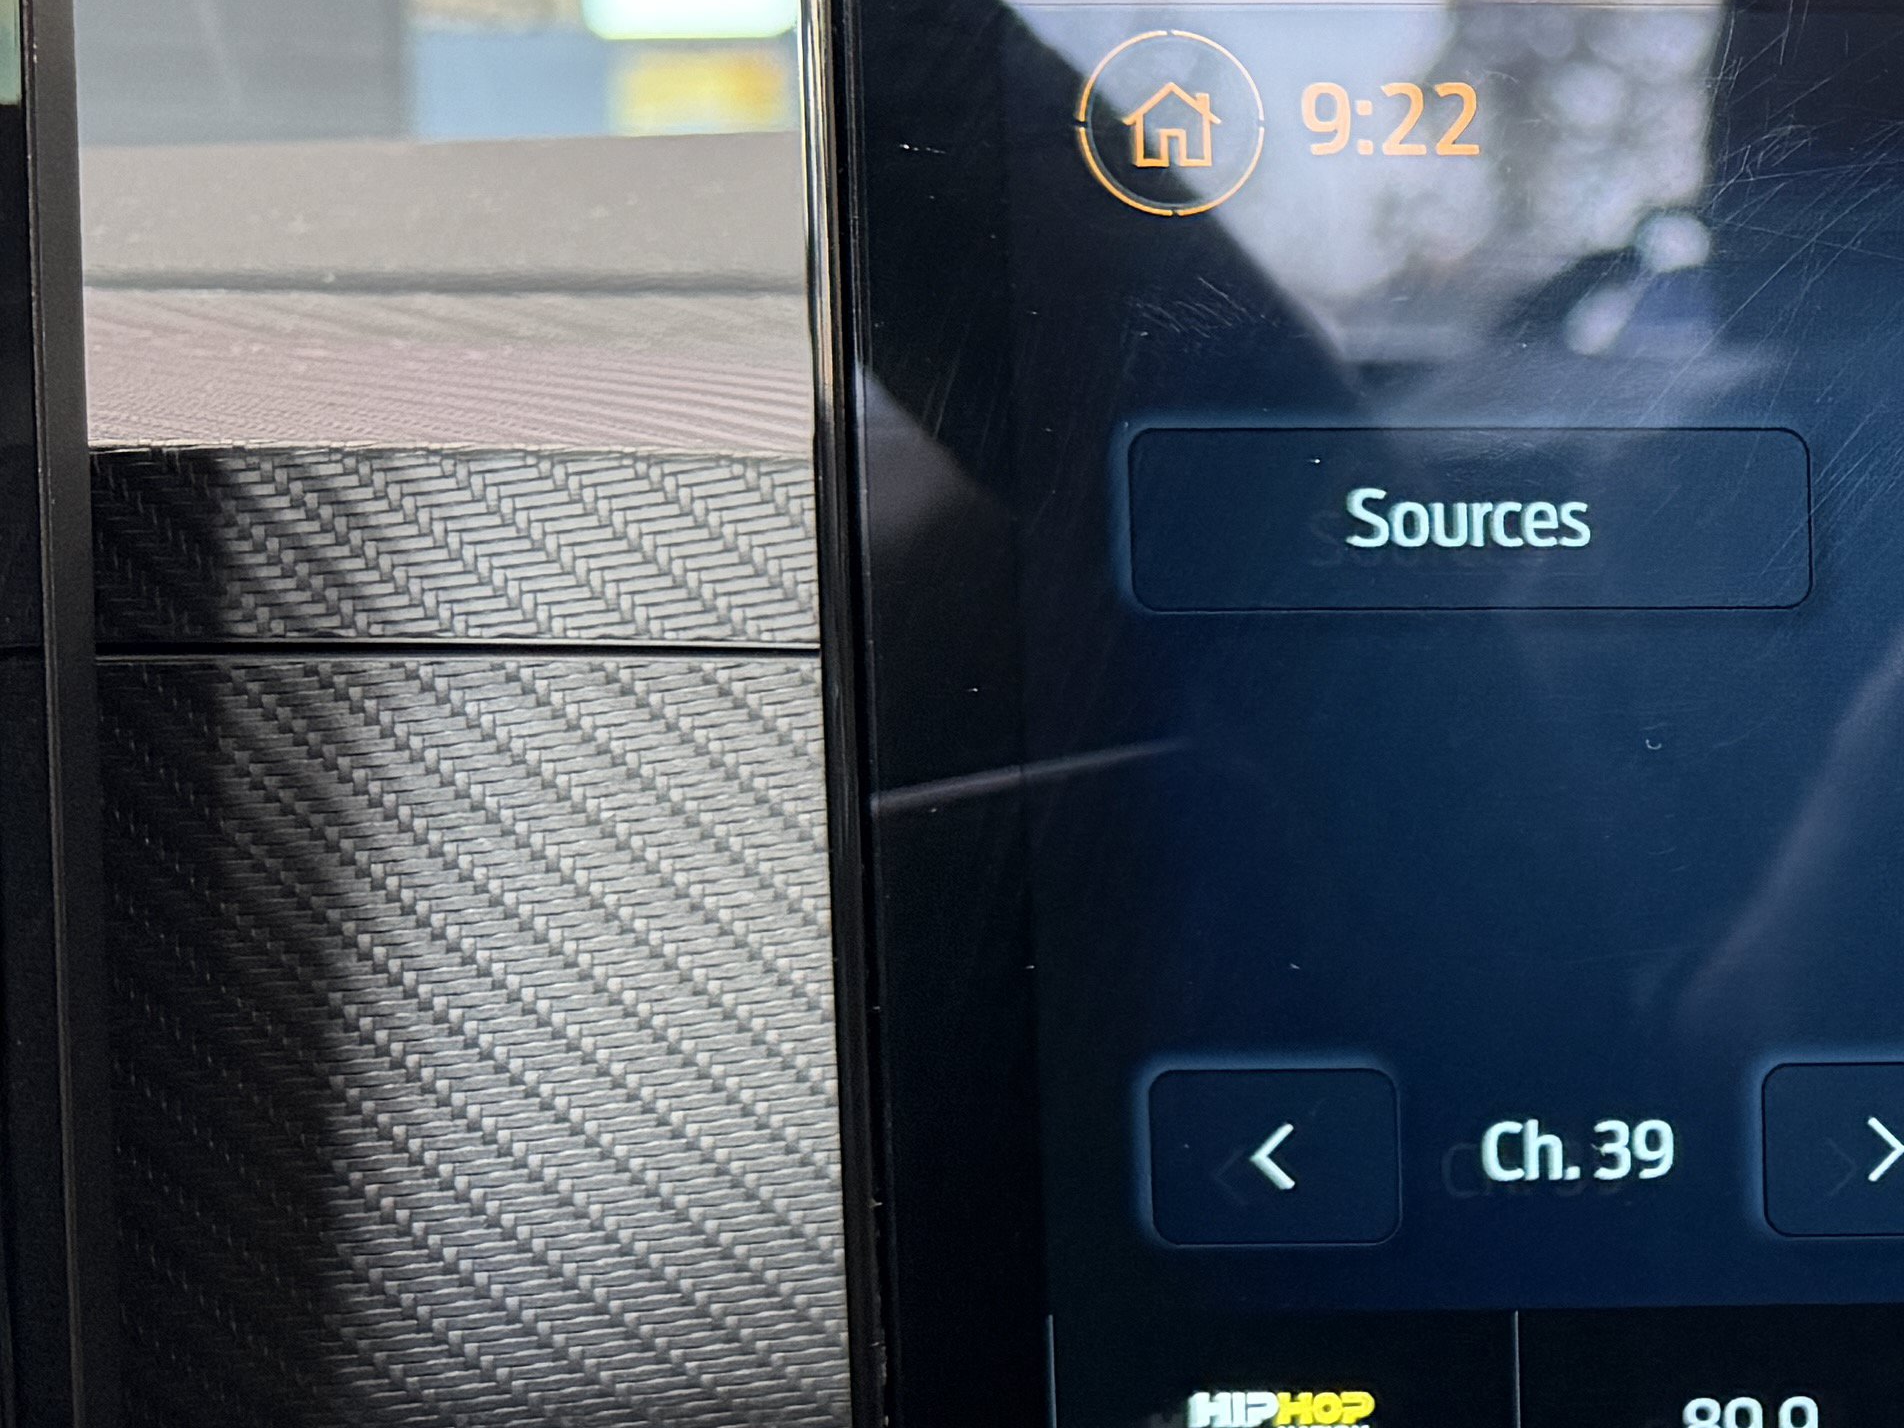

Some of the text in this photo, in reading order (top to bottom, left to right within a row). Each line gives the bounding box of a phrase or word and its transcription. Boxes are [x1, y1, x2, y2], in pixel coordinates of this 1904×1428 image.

[1302, 82, 1480, 156] 9:22
[1347, 488, 1590, 547] Sources
[1483, 1119, 1673, 1181] Ch. 39
